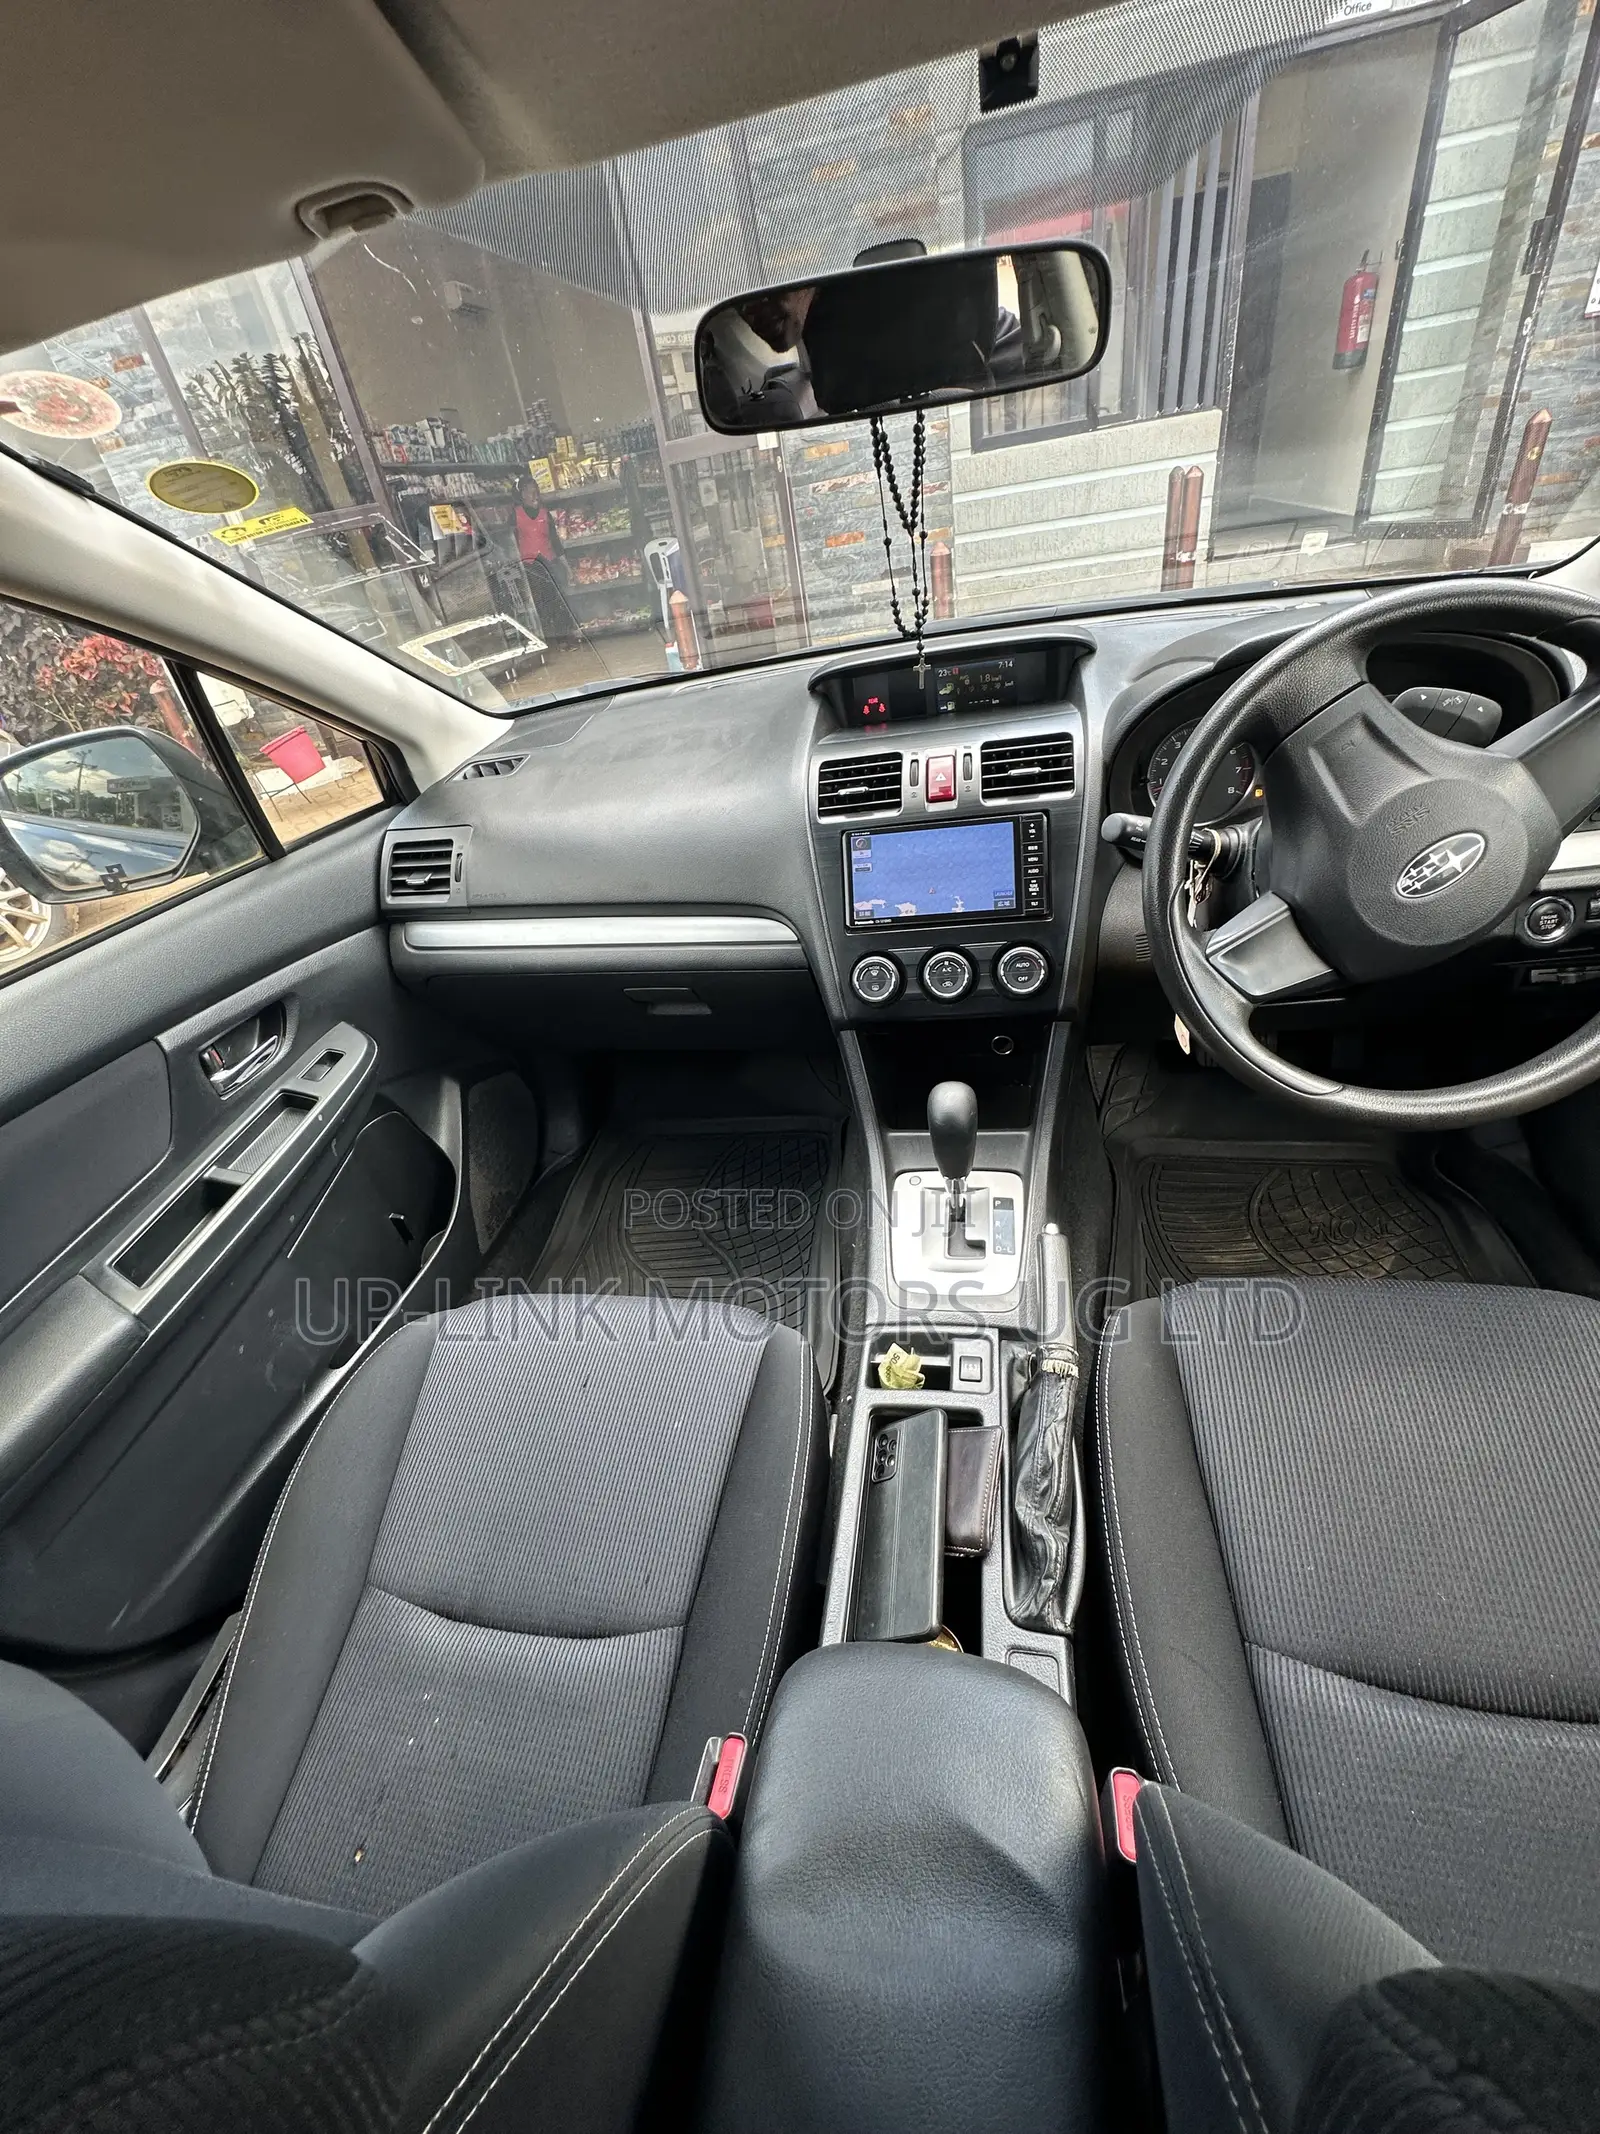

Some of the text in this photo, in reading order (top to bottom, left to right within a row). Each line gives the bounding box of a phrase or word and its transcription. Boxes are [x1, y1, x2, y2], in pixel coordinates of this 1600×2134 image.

[1343, 2, 1372, 16] Office
[998, 660, 1013, 668] 7:14
[1174, 741, 1182, 749] 3
[1160, 758, 1168, 766] 2
[1235, 766, 1242, 774] 7
[1227, 786, 1235, 794] 8
